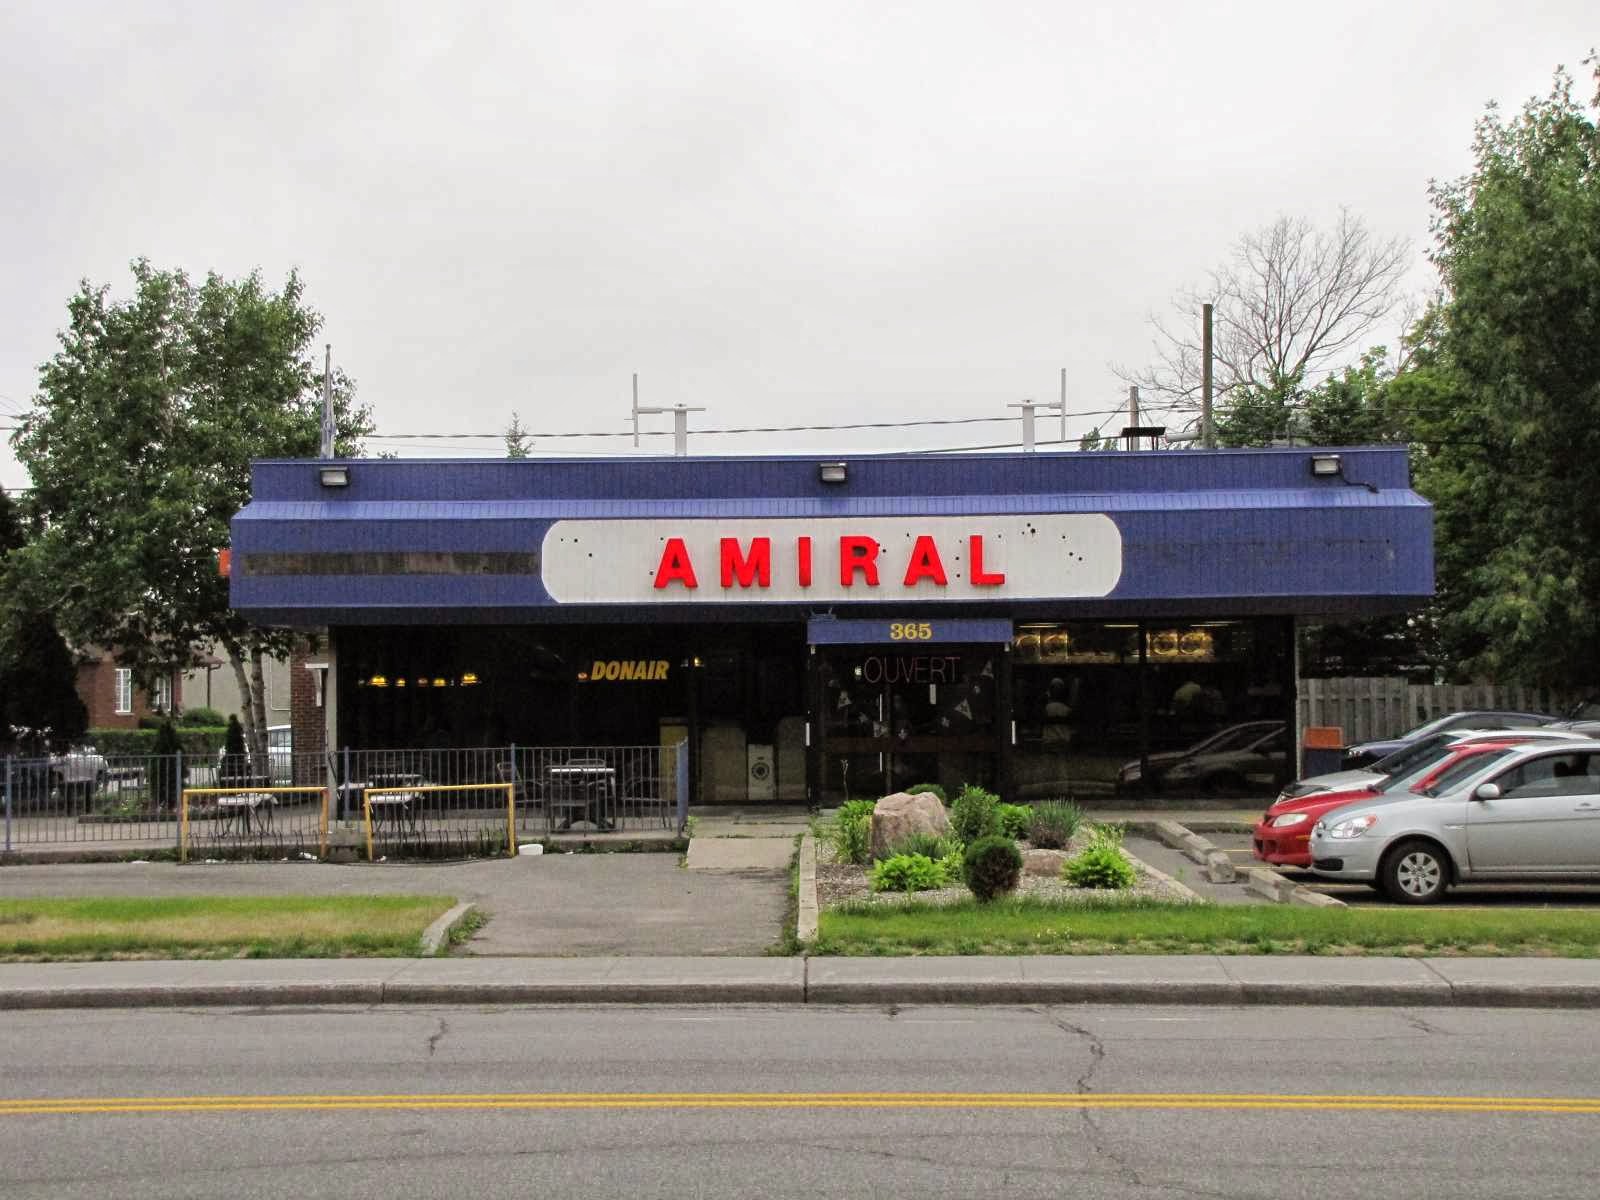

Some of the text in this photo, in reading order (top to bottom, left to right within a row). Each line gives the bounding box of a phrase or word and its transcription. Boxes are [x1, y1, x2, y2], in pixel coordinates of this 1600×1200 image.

[653, 535, 1006, 588] AMIRAL
[889, 623, 933, 641] 365
[591, 660, 670, 681] DONAIR
[864, 656, 961, 684] OUVERT
